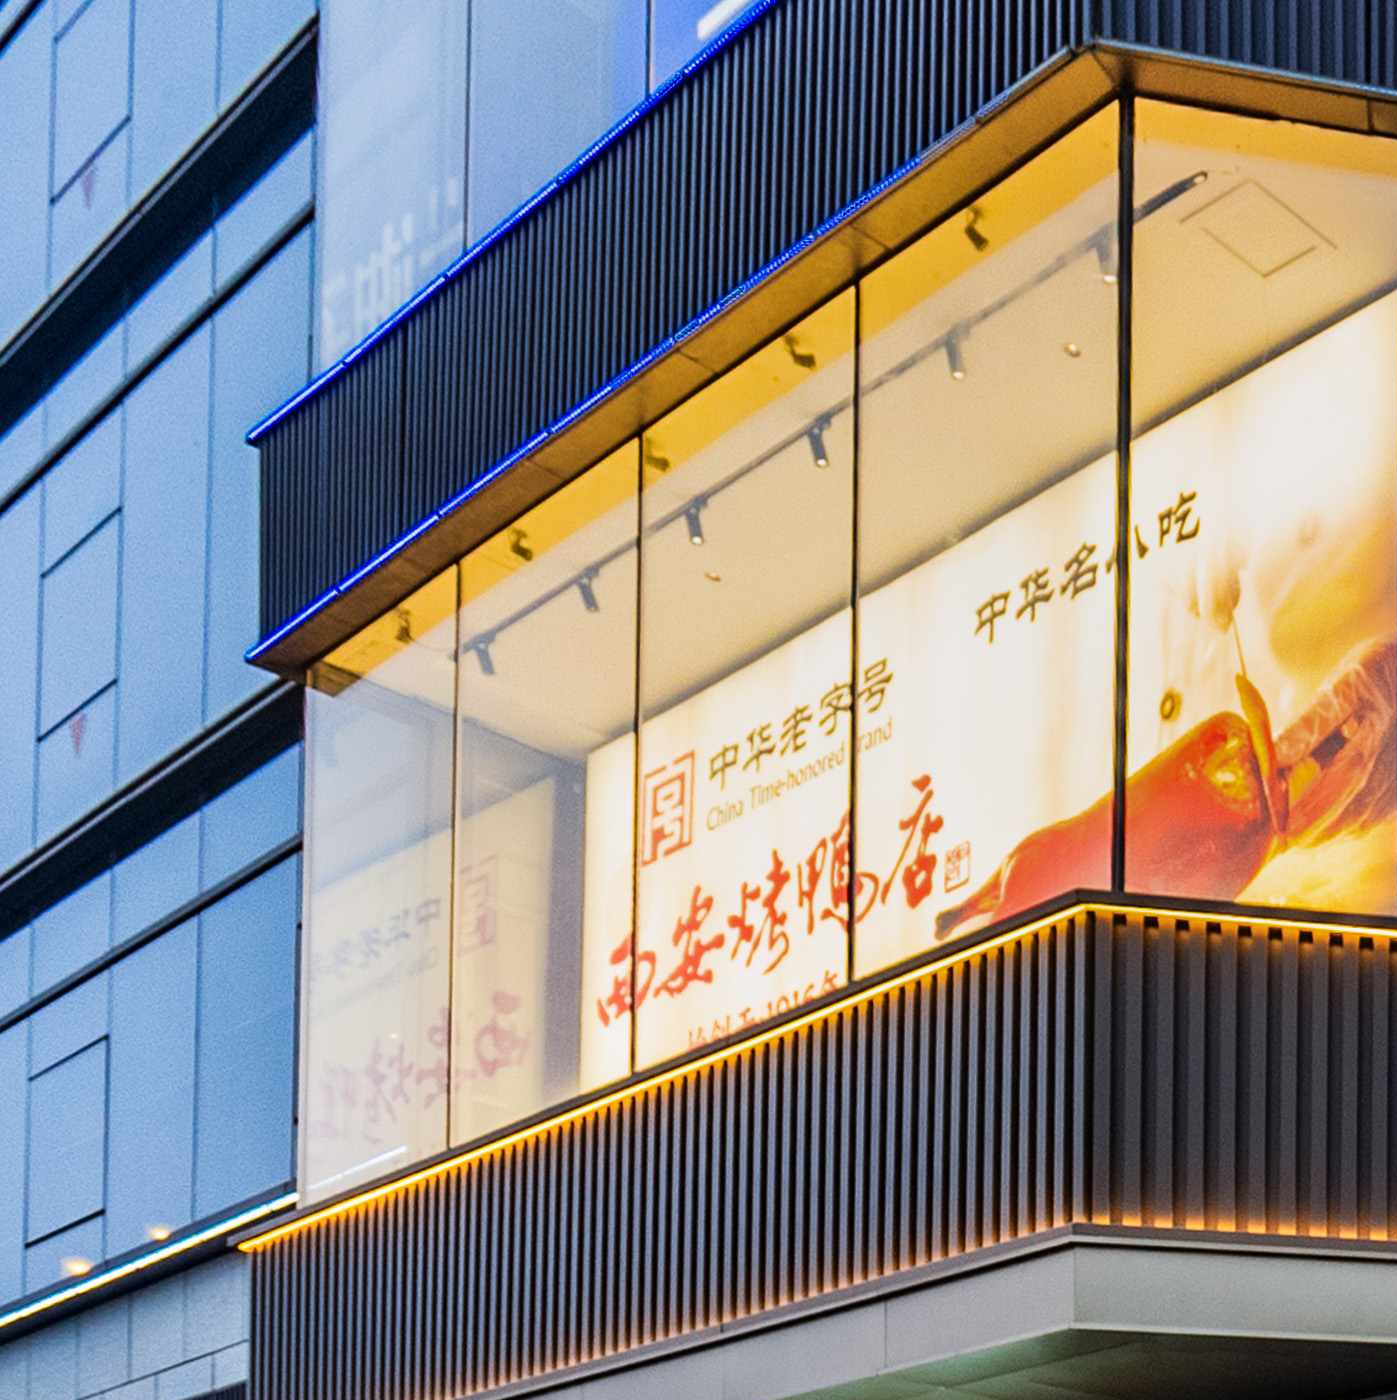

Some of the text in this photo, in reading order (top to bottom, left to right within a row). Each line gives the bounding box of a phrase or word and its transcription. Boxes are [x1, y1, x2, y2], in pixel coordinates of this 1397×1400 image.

[706, 714, 893, 832] China Time-honored rand
[708, 657, 895, 792] 中华老字号
